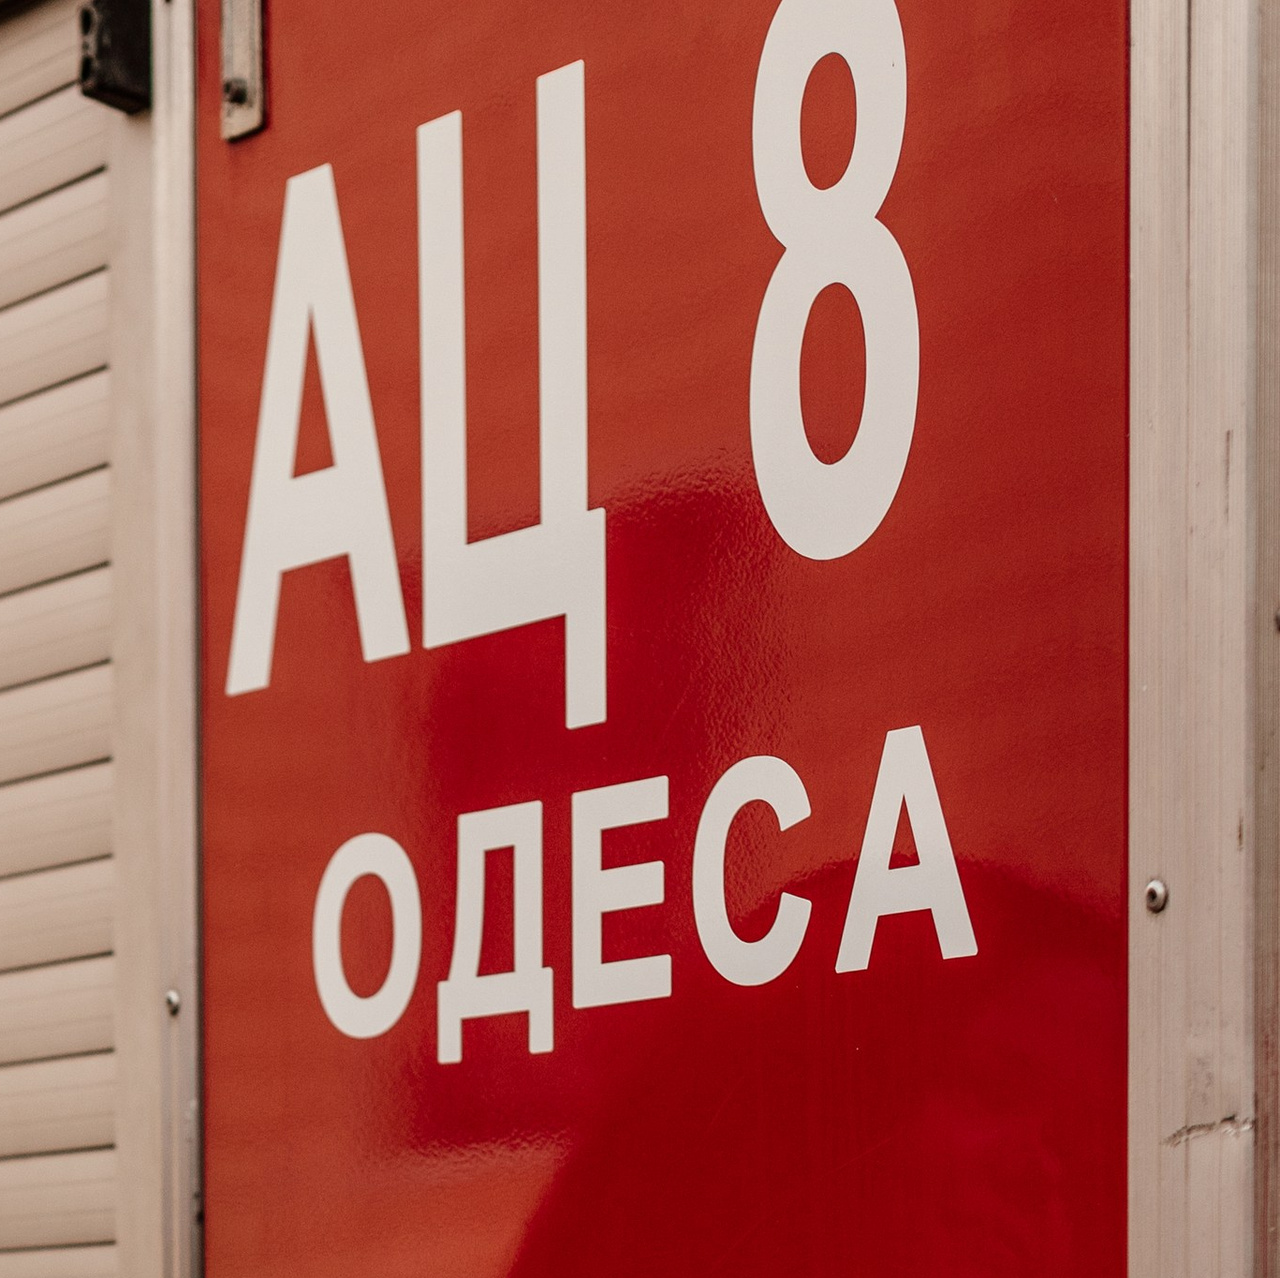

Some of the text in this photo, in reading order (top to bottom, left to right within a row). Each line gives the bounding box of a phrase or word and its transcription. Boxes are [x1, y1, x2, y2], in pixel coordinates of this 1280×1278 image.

[226, 0, 919, 729] АЦ 8
[313, 725, 978, 1063] ОДЕСА
